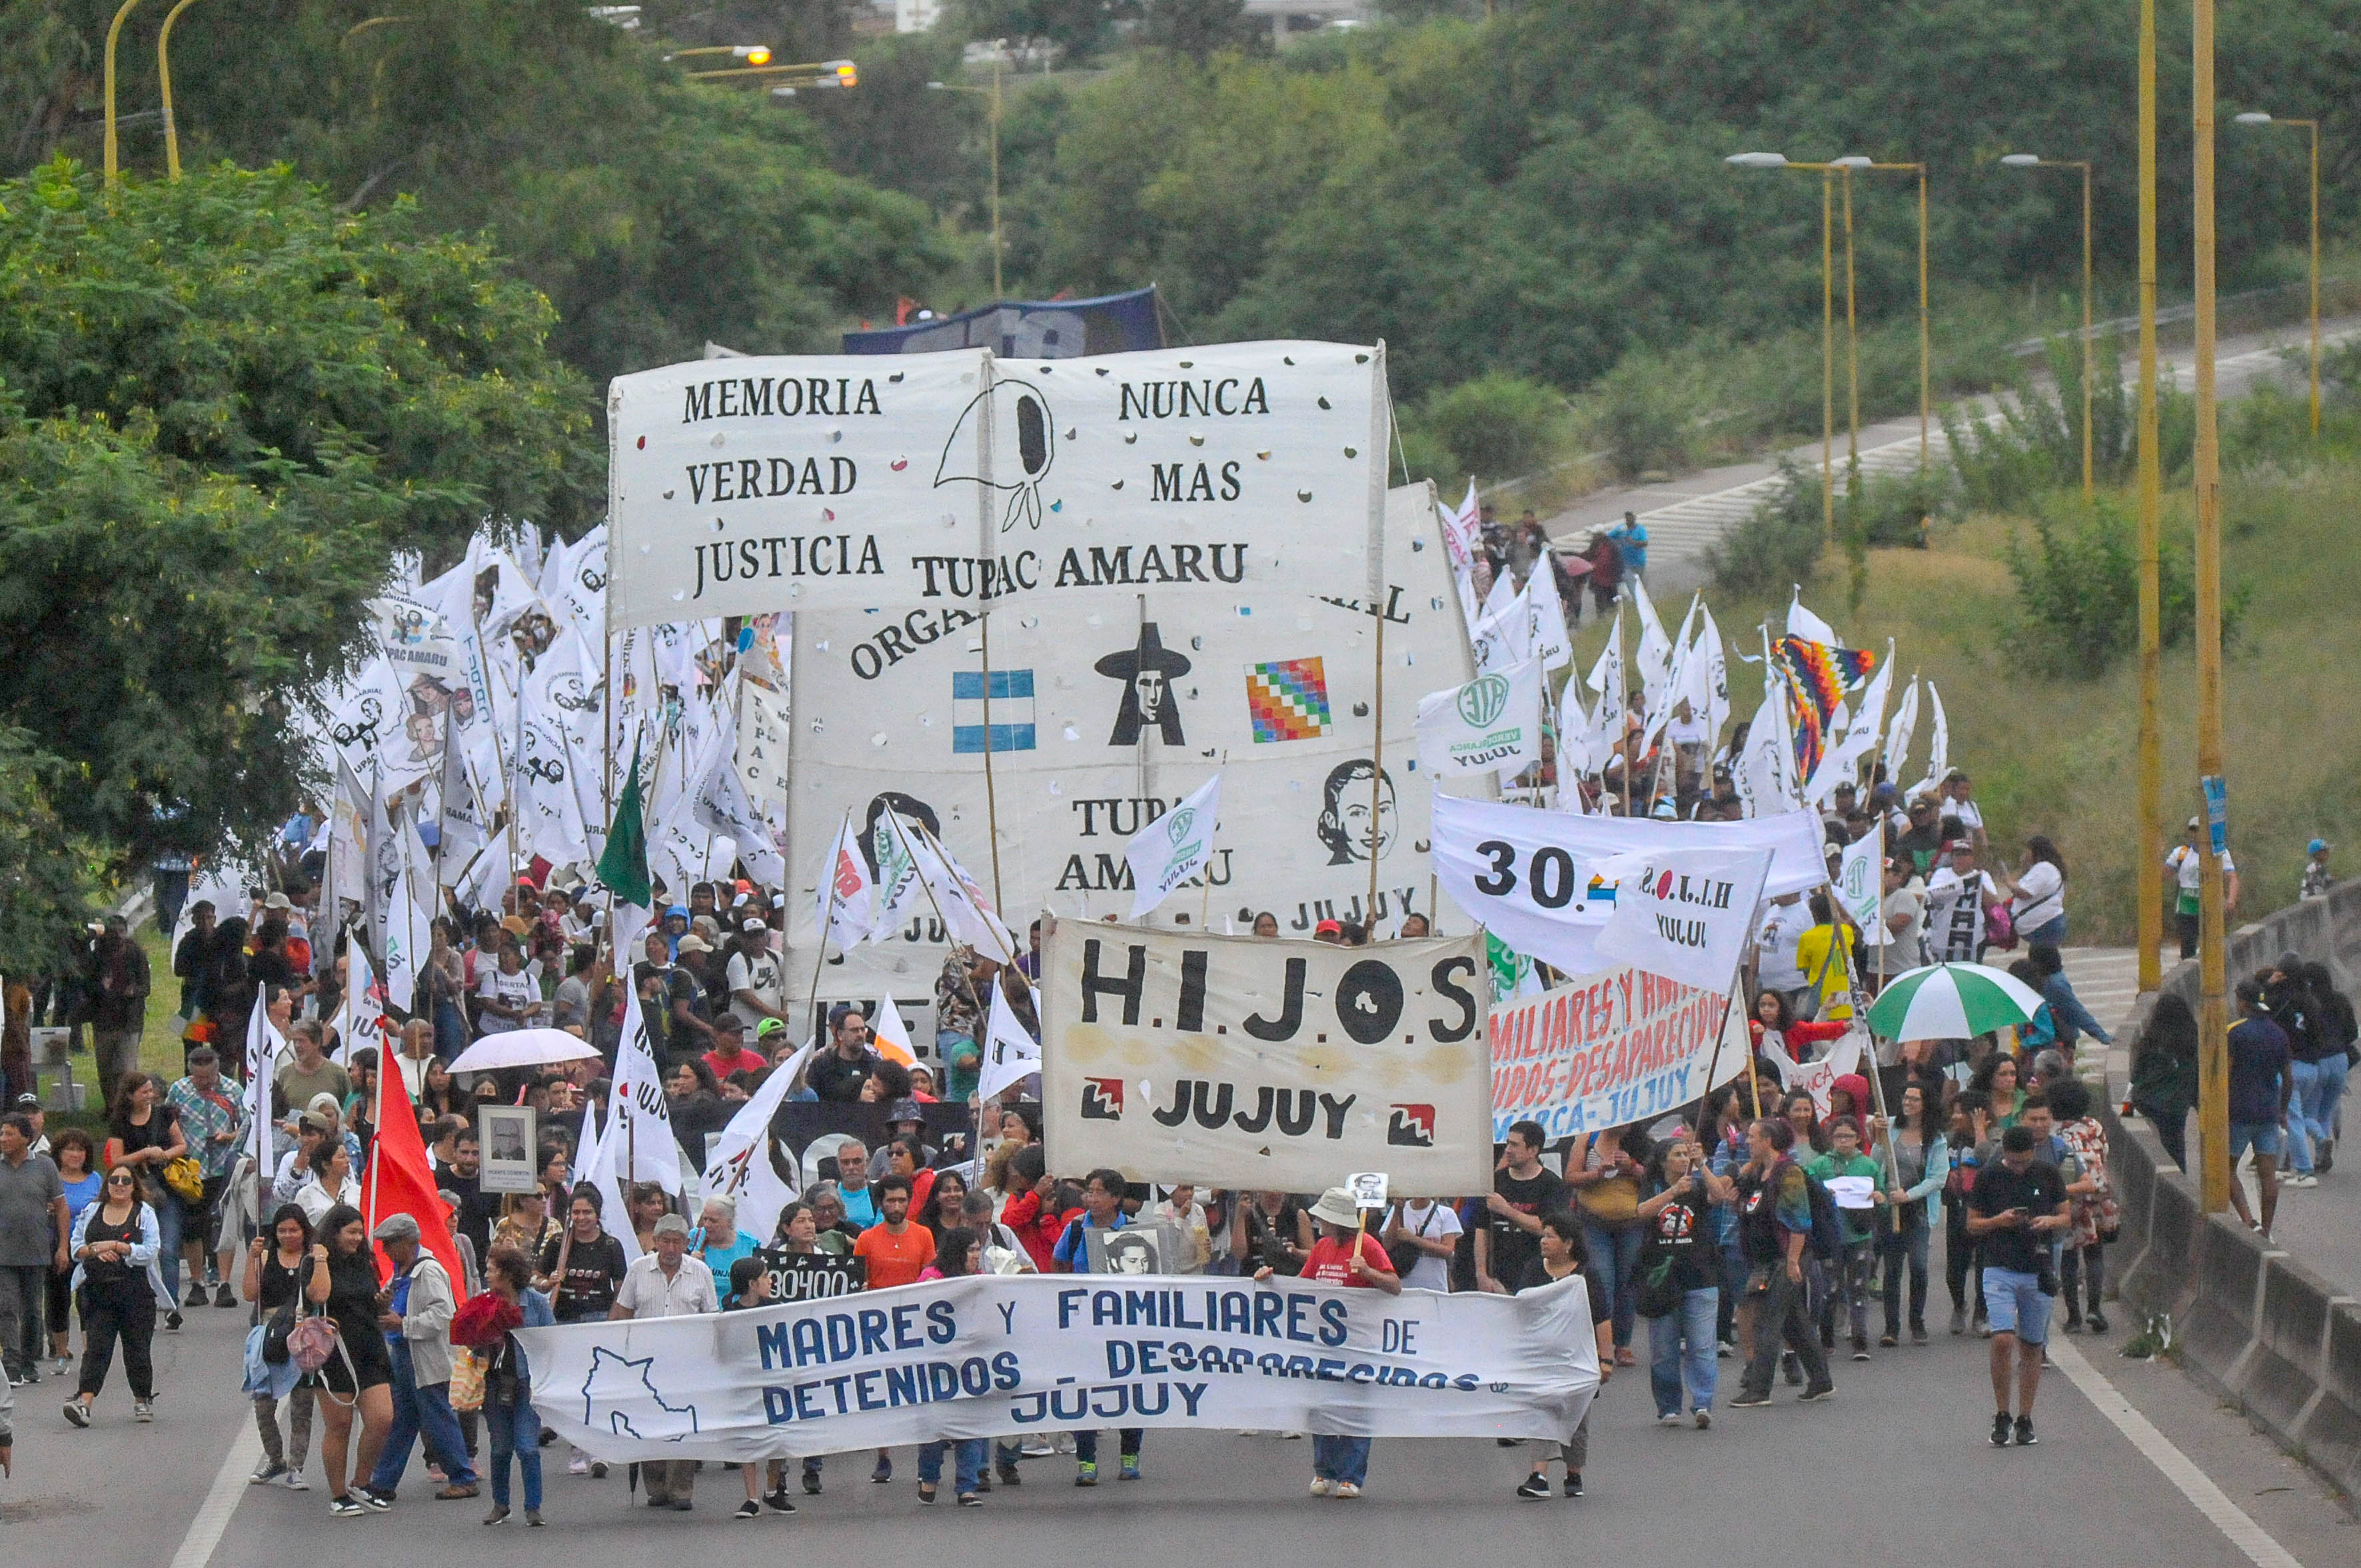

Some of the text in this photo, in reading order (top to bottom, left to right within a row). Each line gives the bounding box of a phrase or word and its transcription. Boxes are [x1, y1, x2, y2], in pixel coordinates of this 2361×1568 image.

[682, 378, 882, 424] MEMORIA
[1119, 377, 1269, 420] NUNCA
[686, 456, 858, 504] VERDAD
[1151, 460, 1241, 502] MAS
[693, 534, 884, 599] JUSTICIA
[912, 543, 1249, 600] TUPAC AMARU
[407, 650, 447, 666] AMARU
[851, 609, 990, 680] ORGA
[1081, 939, 1481, 1044] H.I.J.O.S.
[1489, 978, 1614, 1063] MILIARES
[1619, 968, 1634, 1029] Y
[1152, 1080, 1357, 1139] JUJUY
[768, 1269, 848, 1299] 30400
[756, 1288, 1421, 1369] MADRES Y FAMILIARES DE
[762, 1351, 1021, 1425] DETENIDOS
[1011, 1382, 1209, 1424] JUJUY
